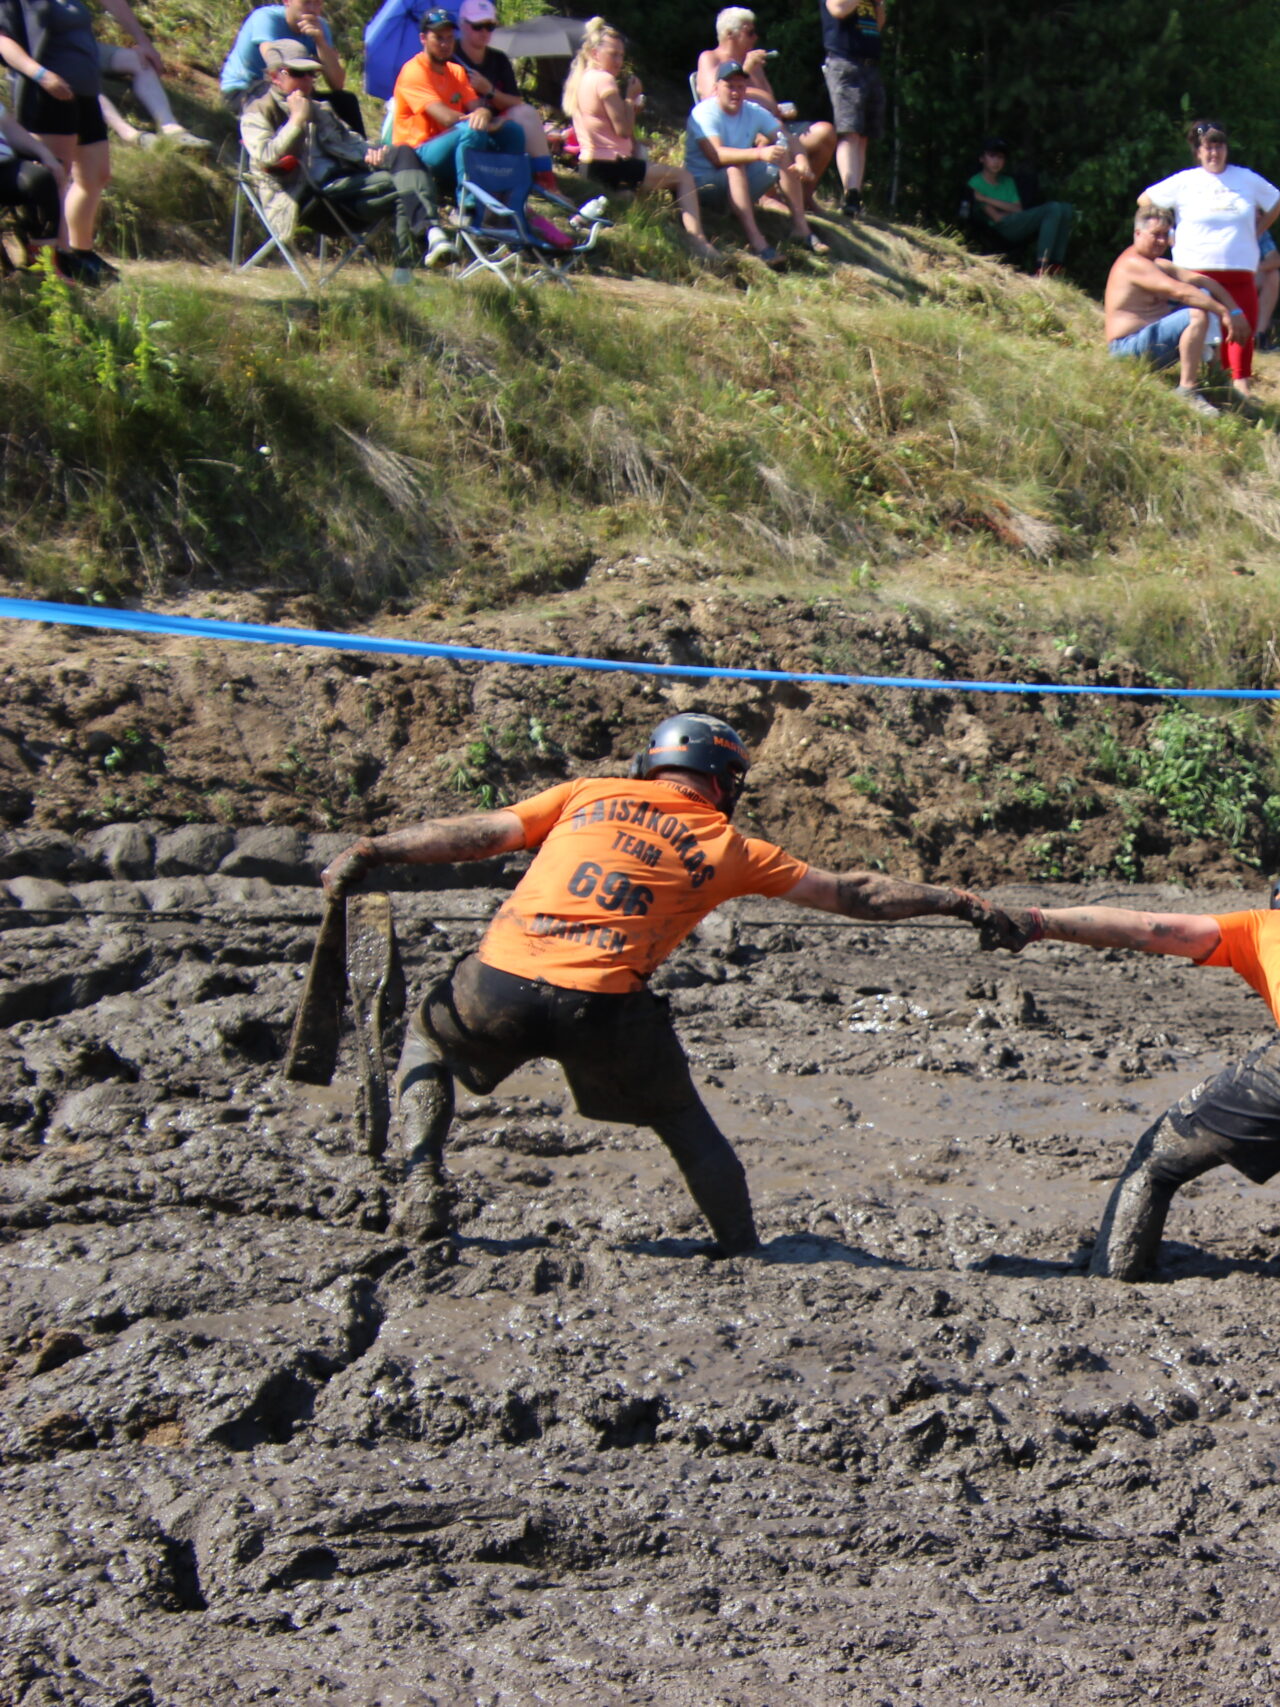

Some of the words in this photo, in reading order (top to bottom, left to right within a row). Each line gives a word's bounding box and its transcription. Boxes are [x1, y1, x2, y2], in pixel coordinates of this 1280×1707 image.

[611, 830, 664, 868] TEAM
[567, 861, 655, 917] 696
[529, 912, 628, 954] MARTEN
